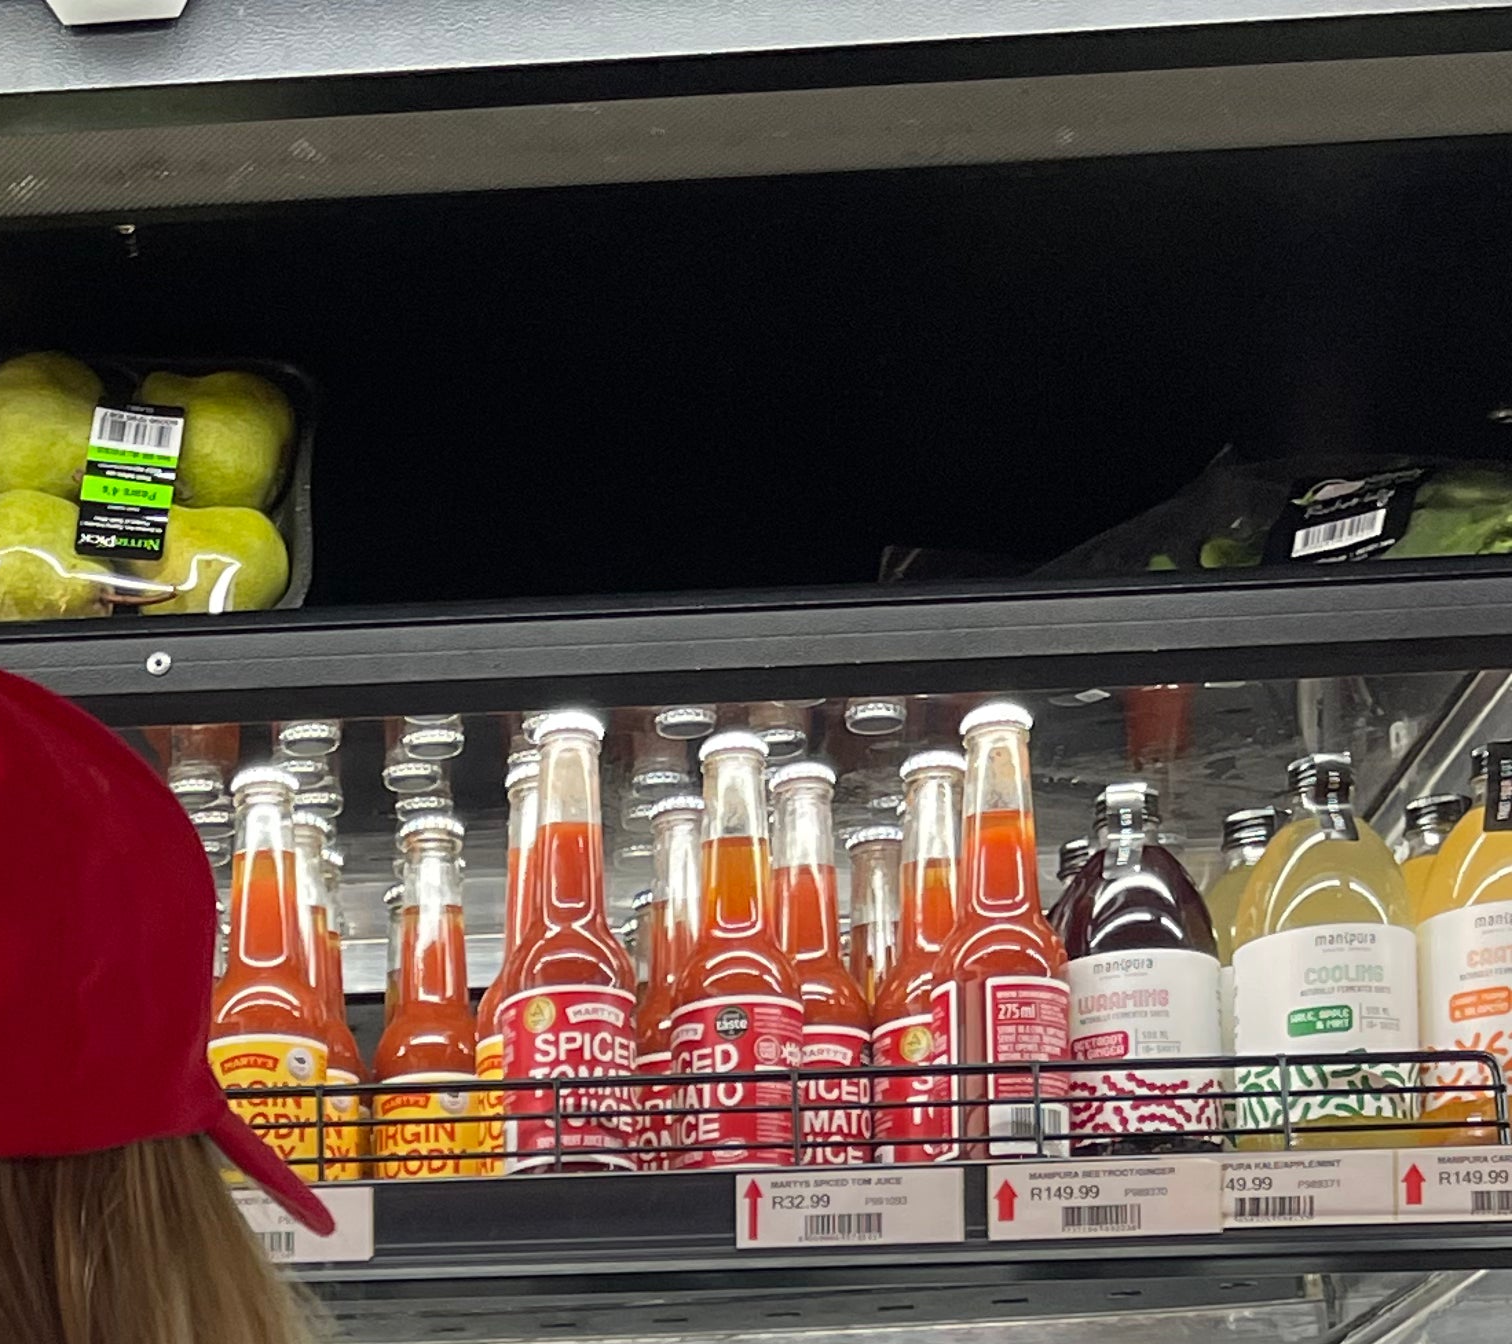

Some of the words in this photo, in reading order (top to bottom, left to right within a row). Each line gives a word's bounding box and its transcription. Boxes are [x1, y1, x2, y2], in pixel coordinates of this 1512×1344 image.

[1315, 932, 1376, 948] manipura
[1304, 963, 1384, 985] COOLING
[572, 1006, 622, 1024] MARTY'S
[1438, 1156, 1488, 1165] MANIPURA
[771, 1180, 810, 1189] MARTYS
[813, 1178, 848, 1188] SPICED
[851, 1177, 872, 1187] TOM
[874, 1177, 903, 1186] JUICE
[1029, 1170, 1079, 1180] MANIPURA
[1439, 1169, 1509, 1186] R149.99
[1030, 1185, 1101, 1201] R149.99
[771, 1194, 830, 1210] R32.99
